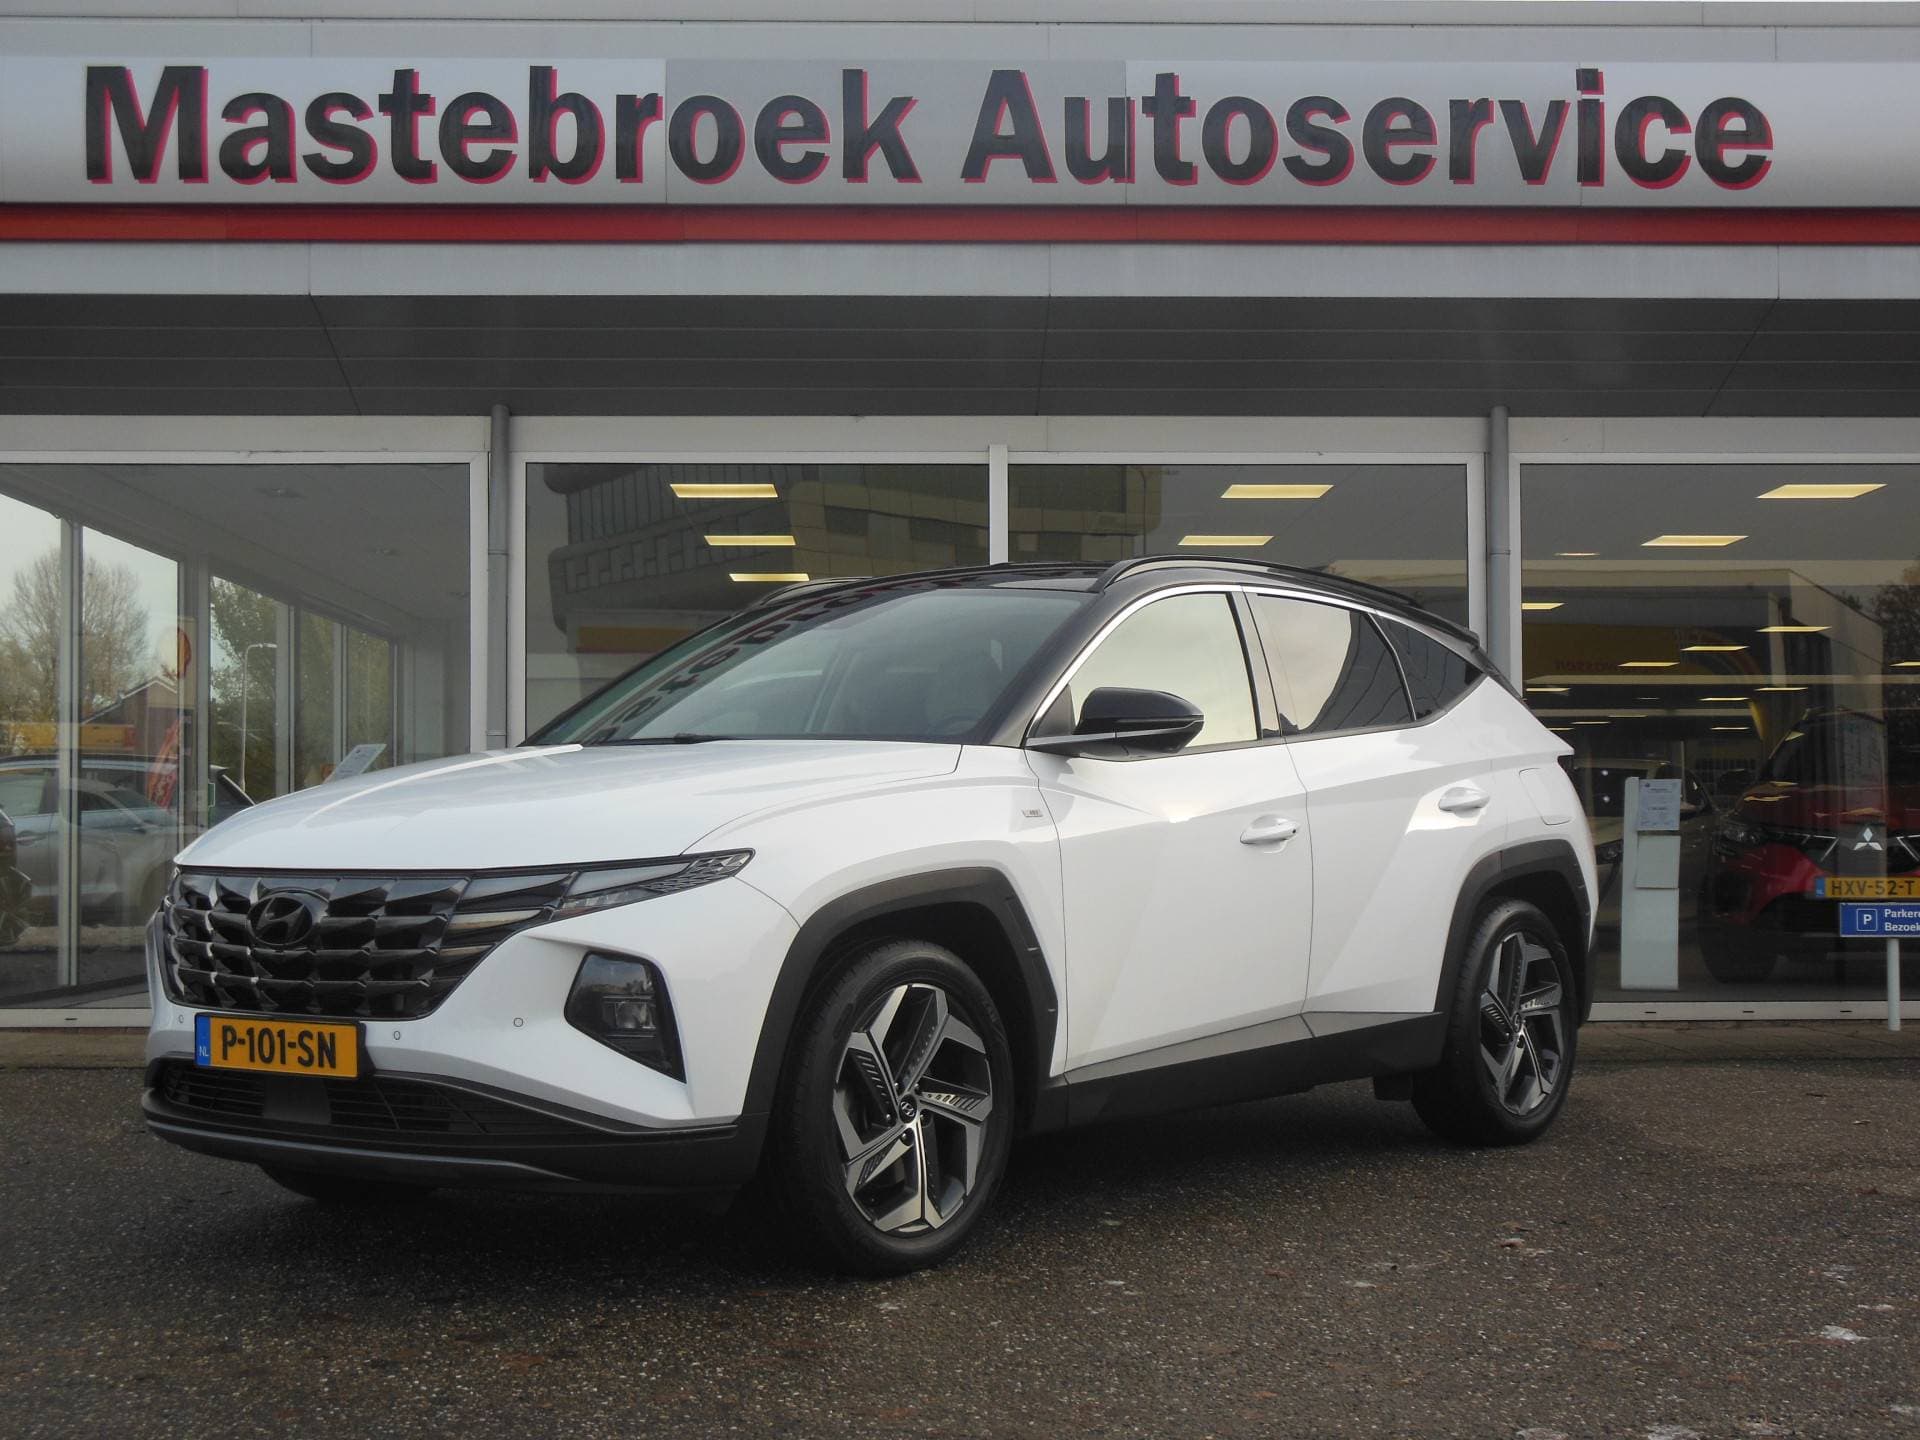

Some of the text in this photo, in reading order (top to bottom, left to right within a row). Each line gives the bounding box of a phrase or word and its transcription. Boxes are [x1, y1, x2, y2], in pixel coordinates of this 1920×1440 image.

[86, 65, 1773, 190] Mastebroek Autoservice
[1831, 880, 1915, 895] HXV-52-T
[1863, 914, 1872, 925] P
[199, 1046, 209, 1057] NL
[221, 1025, 337, 1069] P-101-SN
